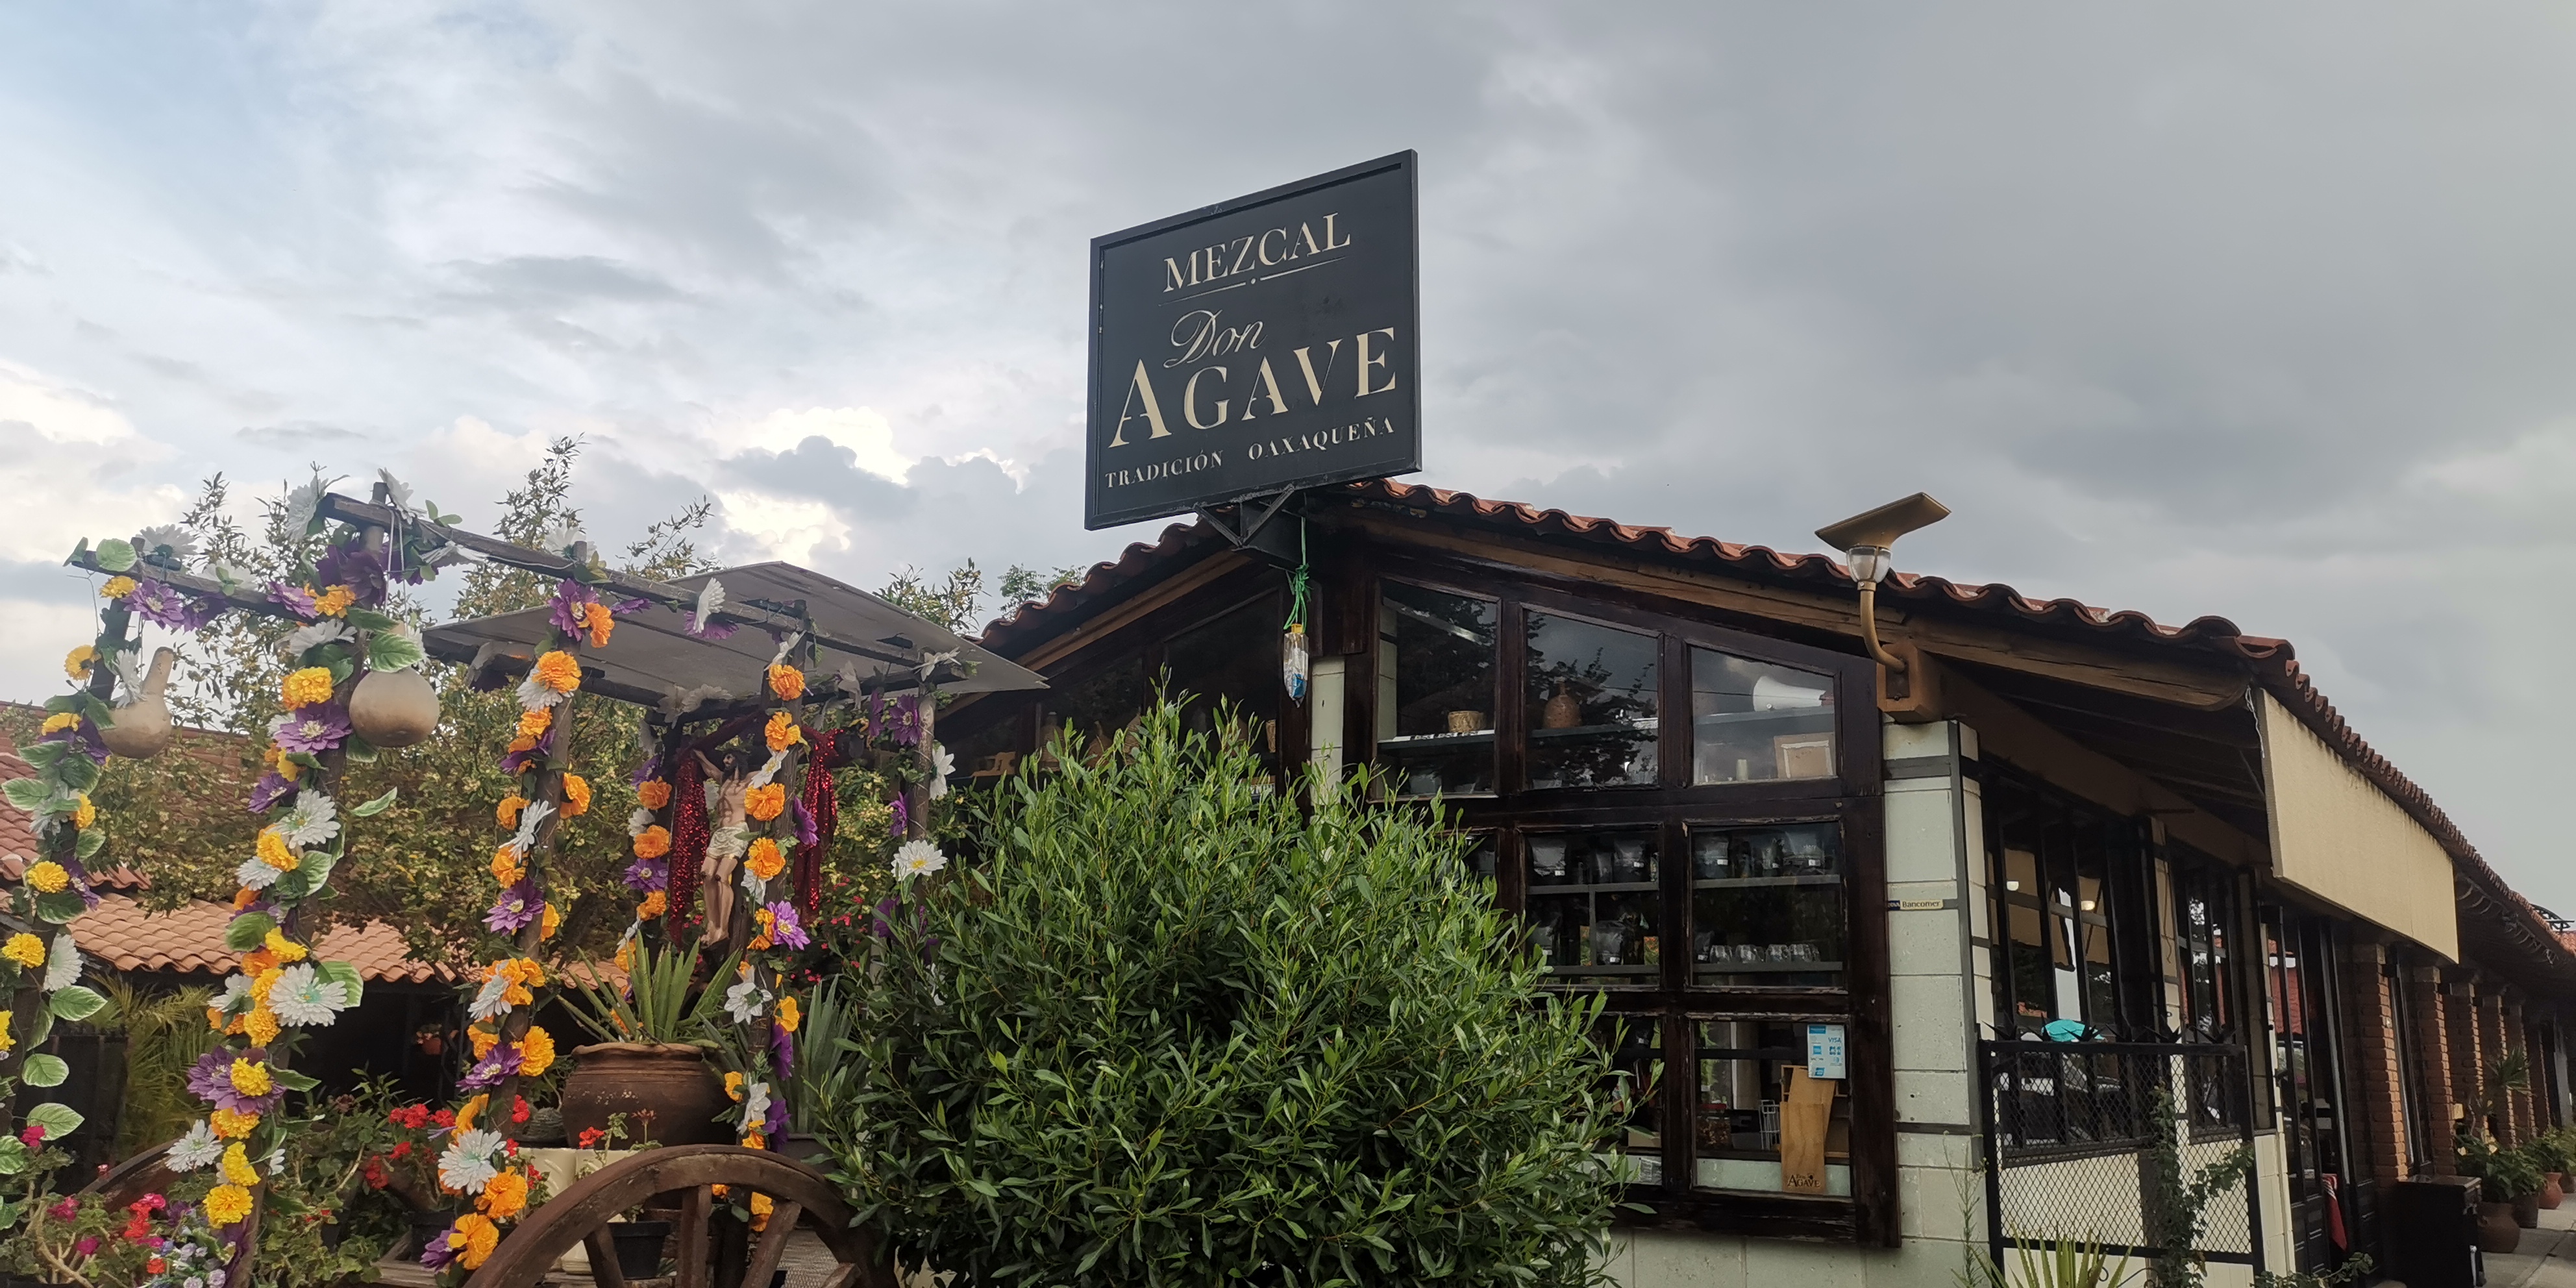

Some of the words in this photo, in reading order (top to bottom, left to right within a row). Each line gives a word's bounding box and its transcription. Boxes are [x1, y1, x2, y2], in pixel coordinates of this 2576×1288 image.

[1163, 212, 1351, 293] MEZCAL
[1163, 309, 1267, 368] Don
[1108, 327, 1396, 449] AGAVE
[1105, 450, 1223, 488] TRADICIÓN
[1248, 416, 1395, 461] OAXAQUEÑA
[1787, 1174, 1821, 1187] AGAVE
